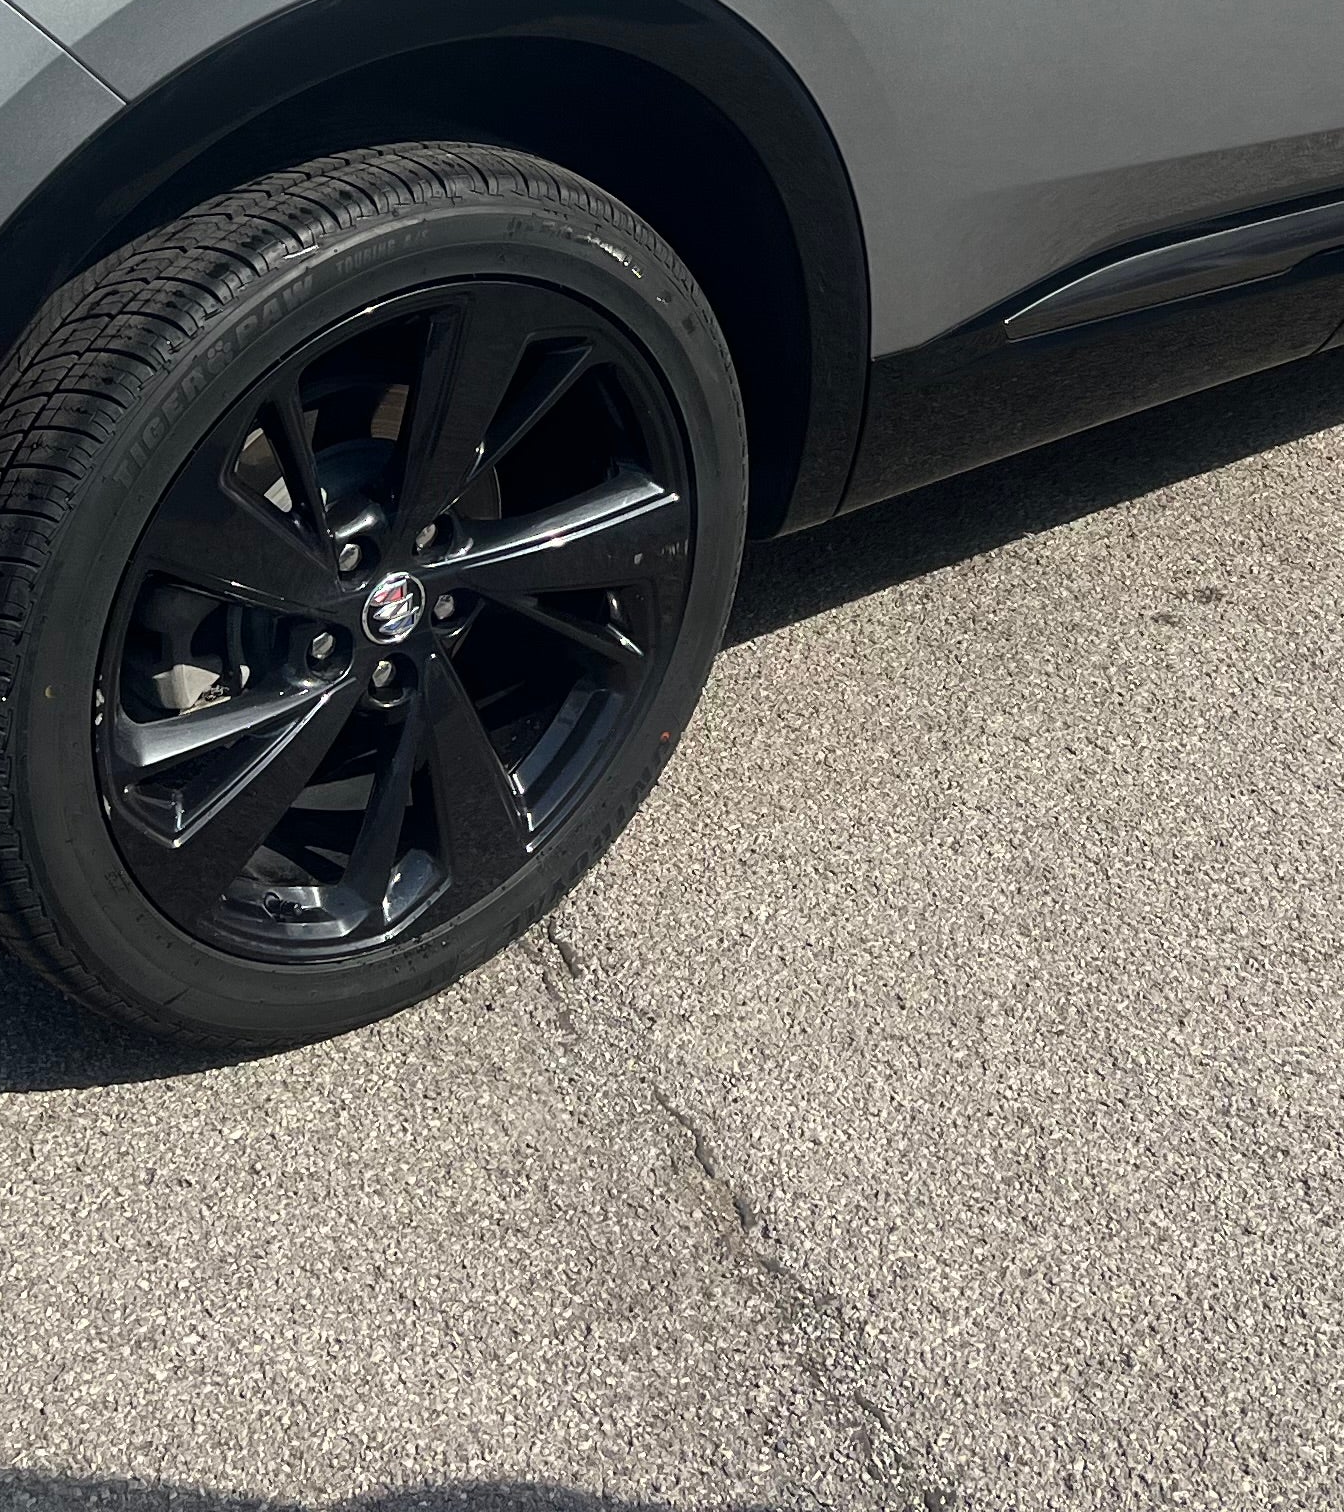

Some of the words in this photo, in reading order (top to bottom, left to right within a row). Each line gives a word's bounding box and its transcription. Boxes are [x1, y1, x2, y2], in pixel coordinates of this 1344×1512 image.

[112, 369, 209, 490] TIGER
[234, 276, 316, 347] PAW
[334, 237, 399, 274] TOURING
